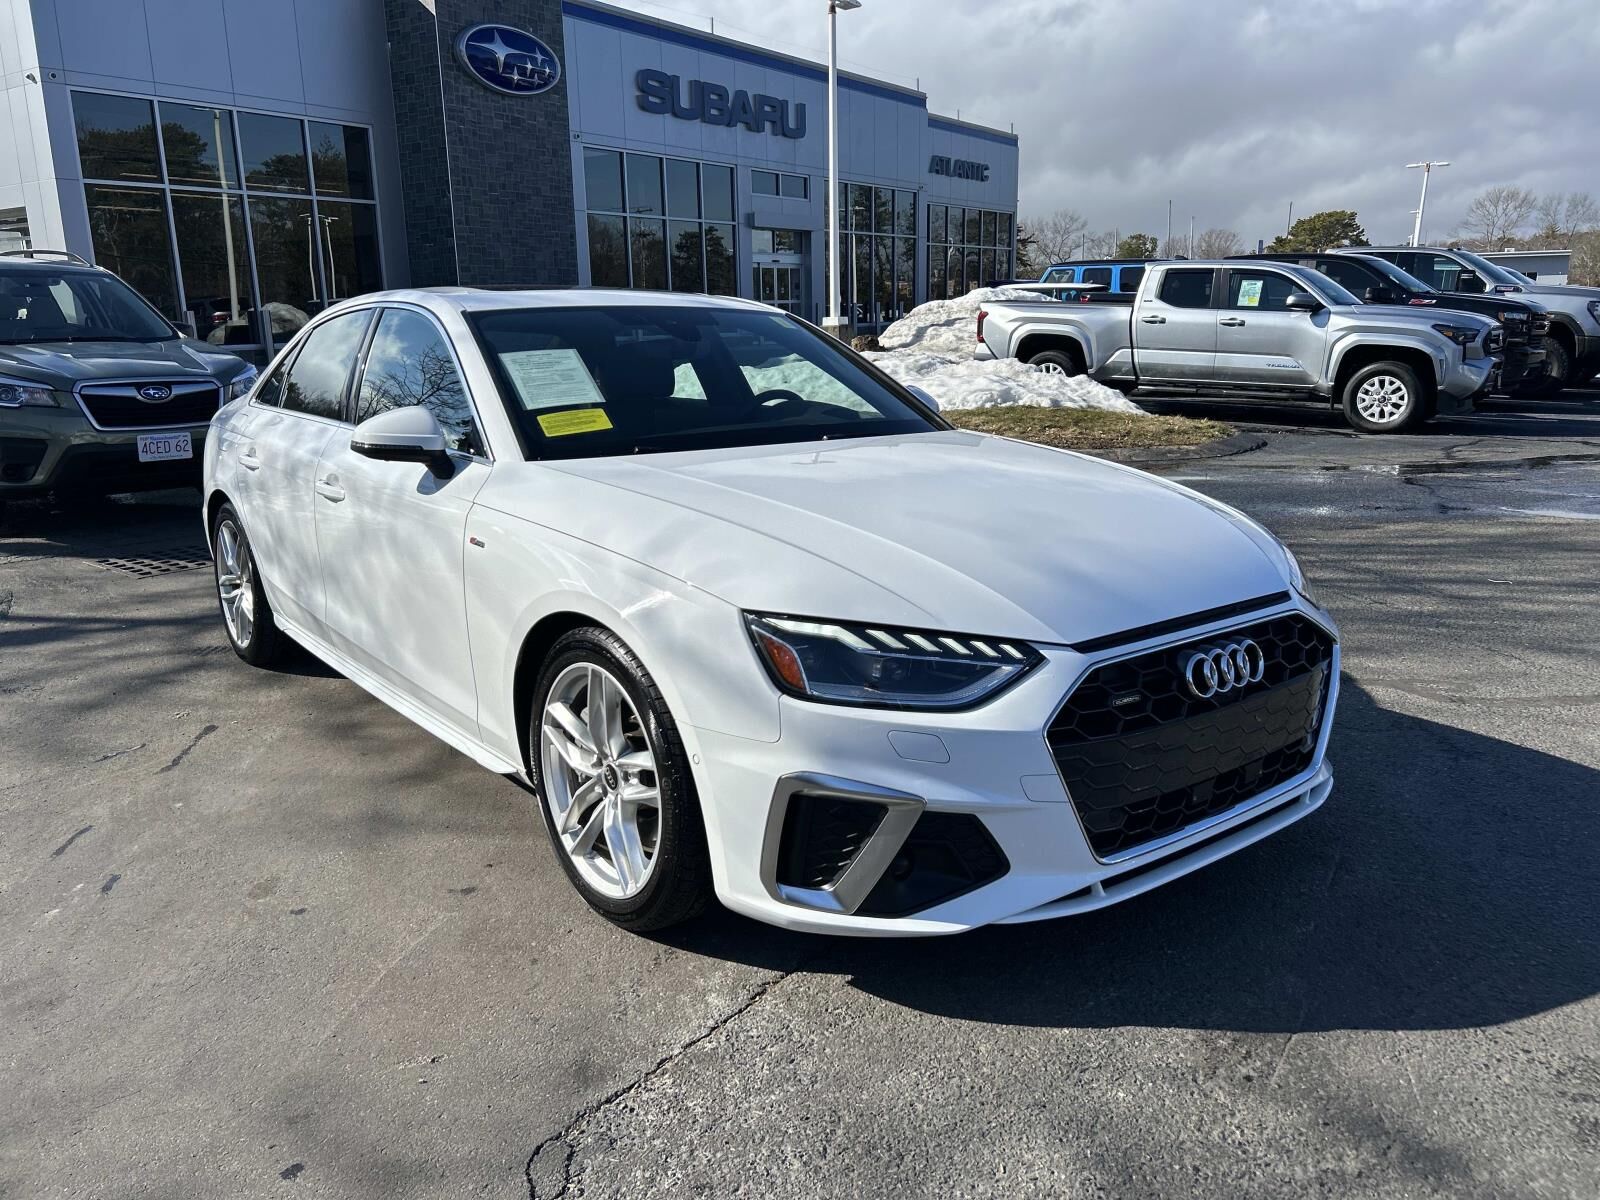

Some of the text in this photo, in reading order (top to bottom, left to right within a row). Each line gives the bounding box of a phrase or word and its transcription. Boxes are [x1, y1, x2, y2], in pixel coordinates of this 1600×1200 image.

[636, 68, 807, 139] SUBARU
[928, 154, 990, 182] ATLANTIC
[142, 439, 190, 455] 4CED 62
